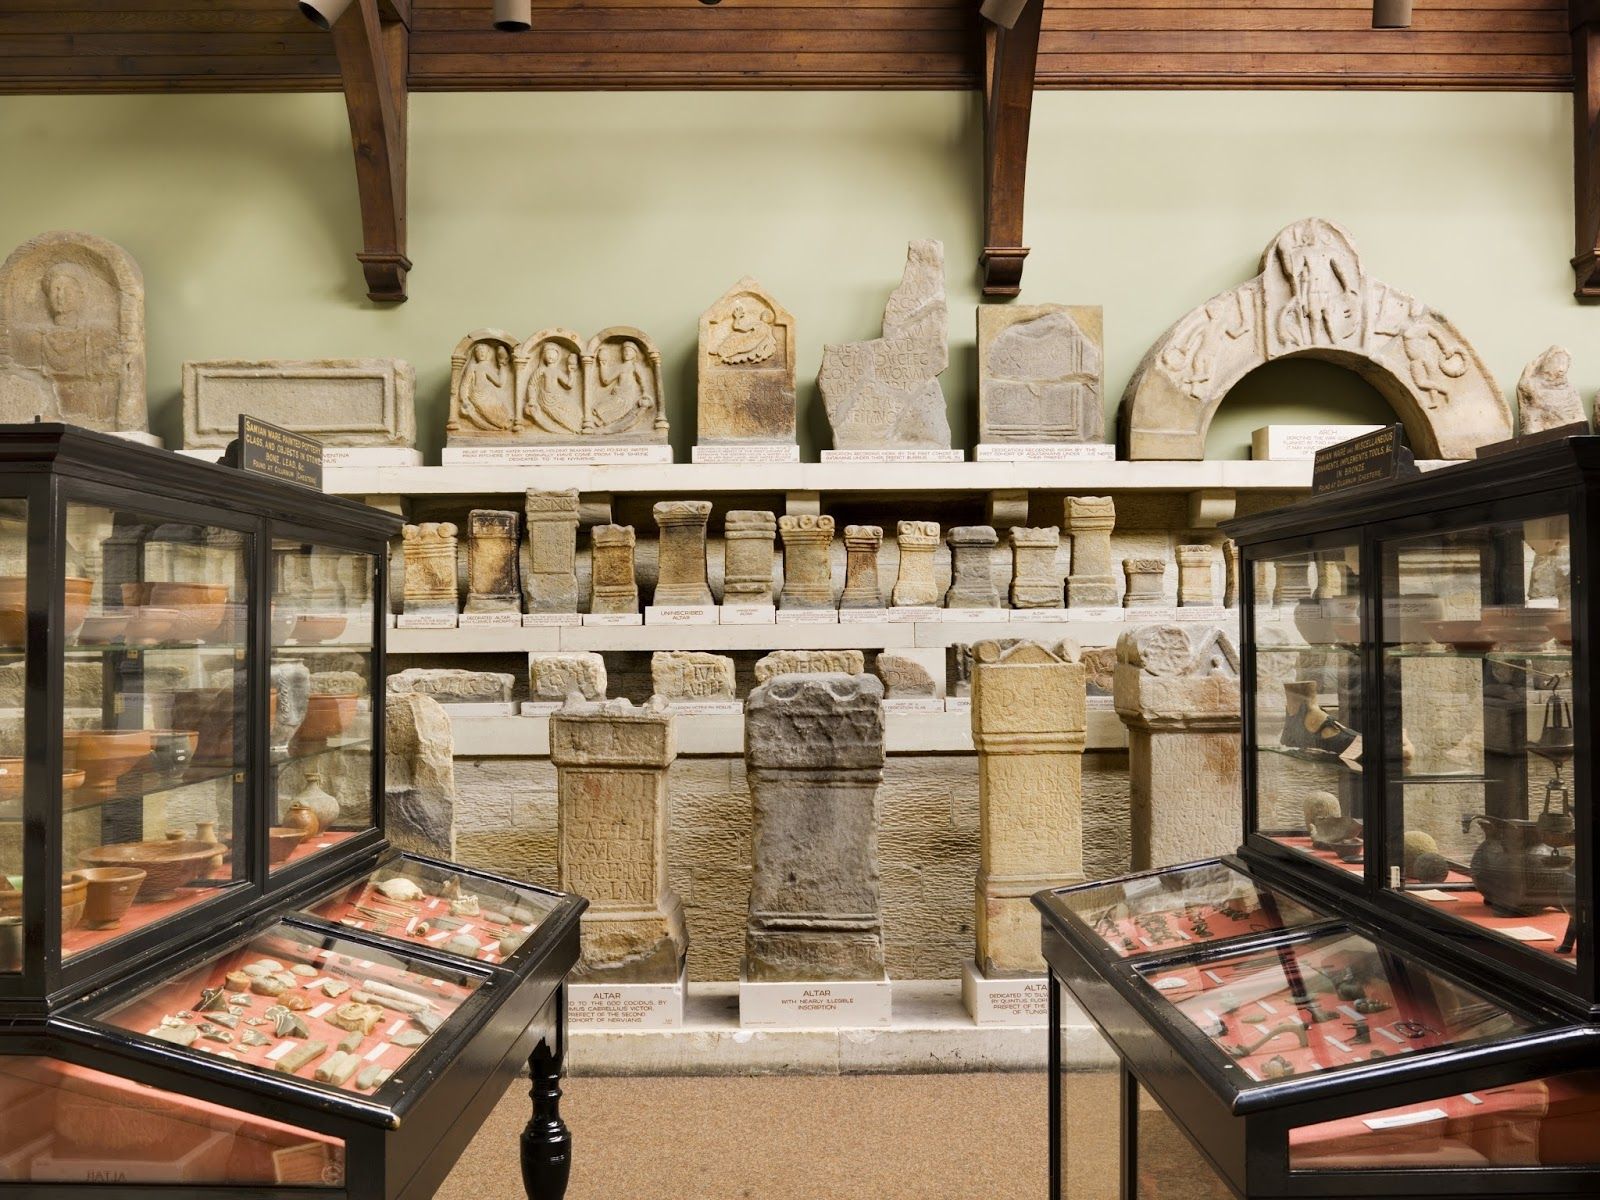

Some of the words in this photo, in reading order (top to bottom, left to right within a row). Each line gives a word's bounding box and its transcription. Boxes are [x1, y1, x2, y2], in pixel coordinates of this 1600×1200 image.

[246, 420, 267, 437] SAMIAN
[282, 434, 301, 448] PAINTED
[264, 440, 275, 451] AND
[277, 444, 299, 459] OBJECTS
[1315, 452, 1332, 464] SAMIAN
[1354, 431, 1393, 451] MISCELLANEOUS
[1336, 470, 1343, 479] IN
[1344, 462, 1365, 476] BRONZE
[1023, 984, 1048, 992] ALTA
